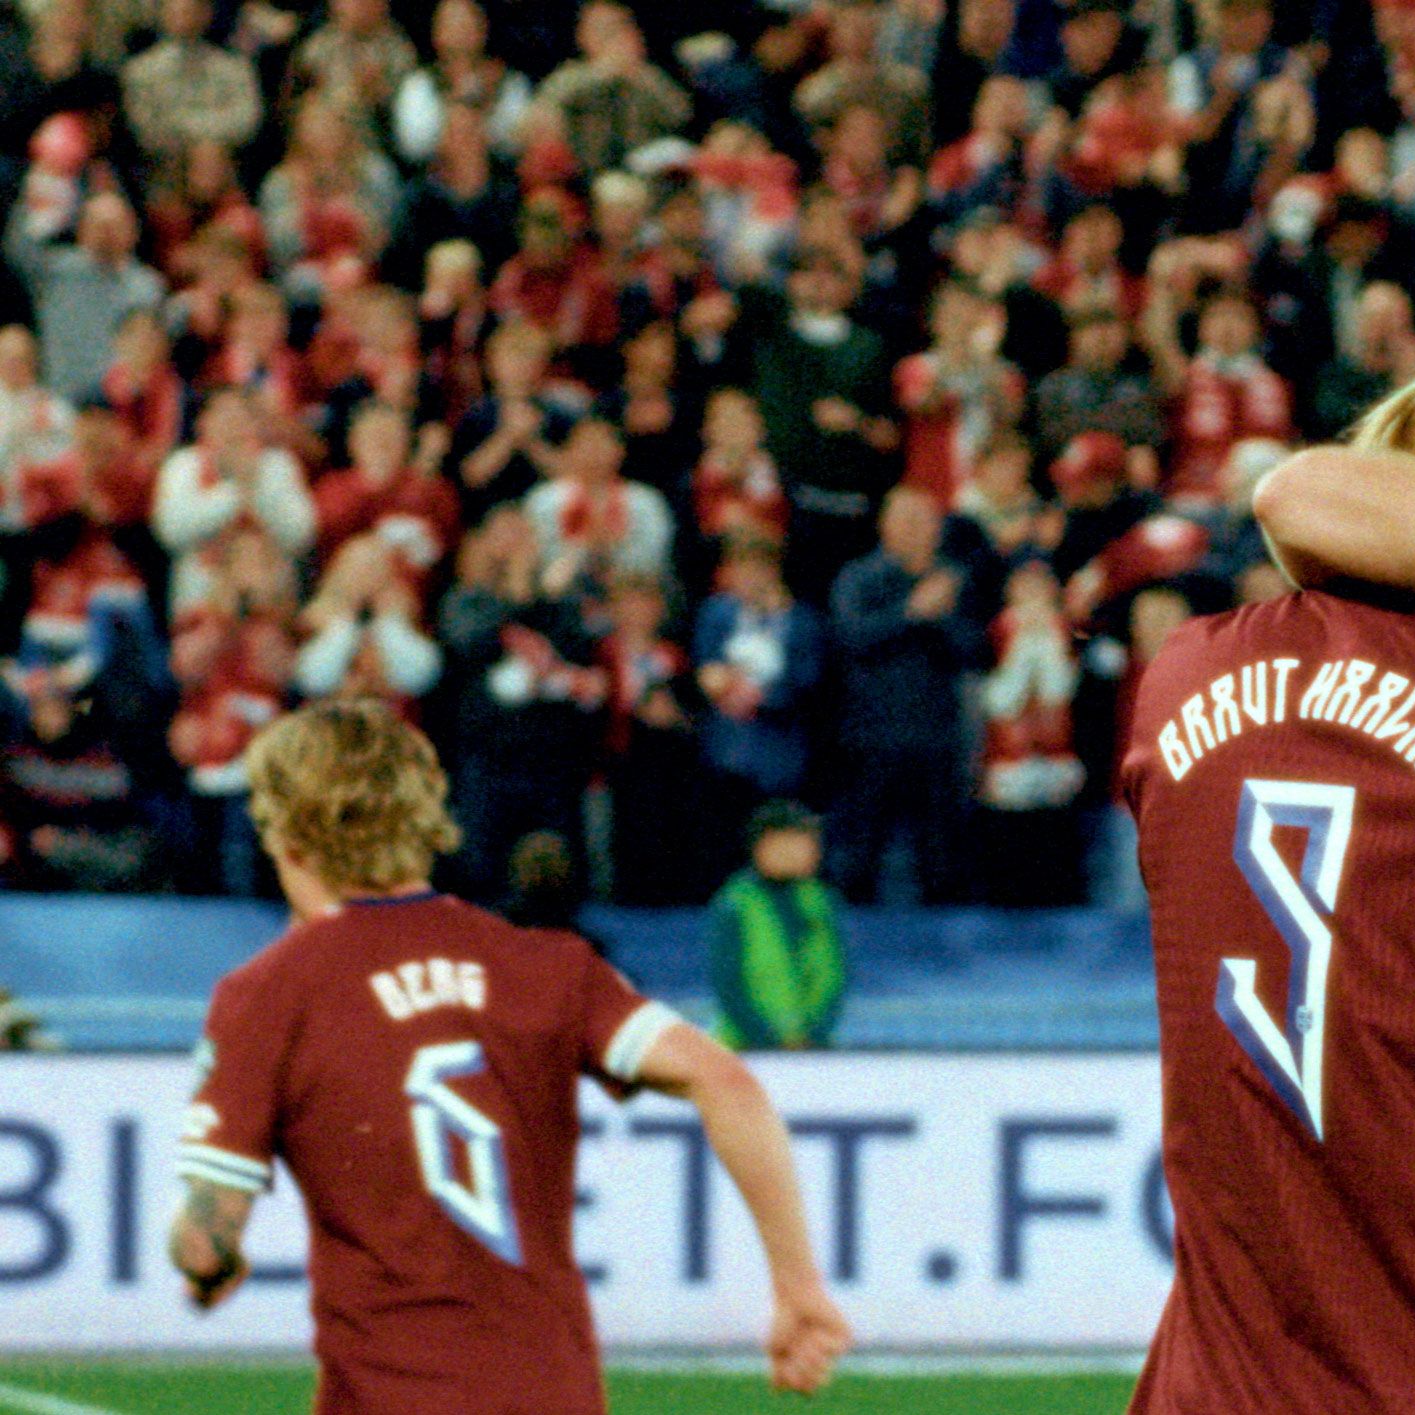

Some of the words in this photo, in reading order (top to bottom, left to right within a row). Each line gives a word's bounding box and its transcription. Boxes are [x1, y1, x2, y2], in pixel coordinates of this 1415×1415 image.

[1158, 658, 1300, 781] BRAUT
[370, 957, 485, 1021] BERG
[1214, 778, 1356, 1144] 9
[404, 1040, 525, 1267] 6
